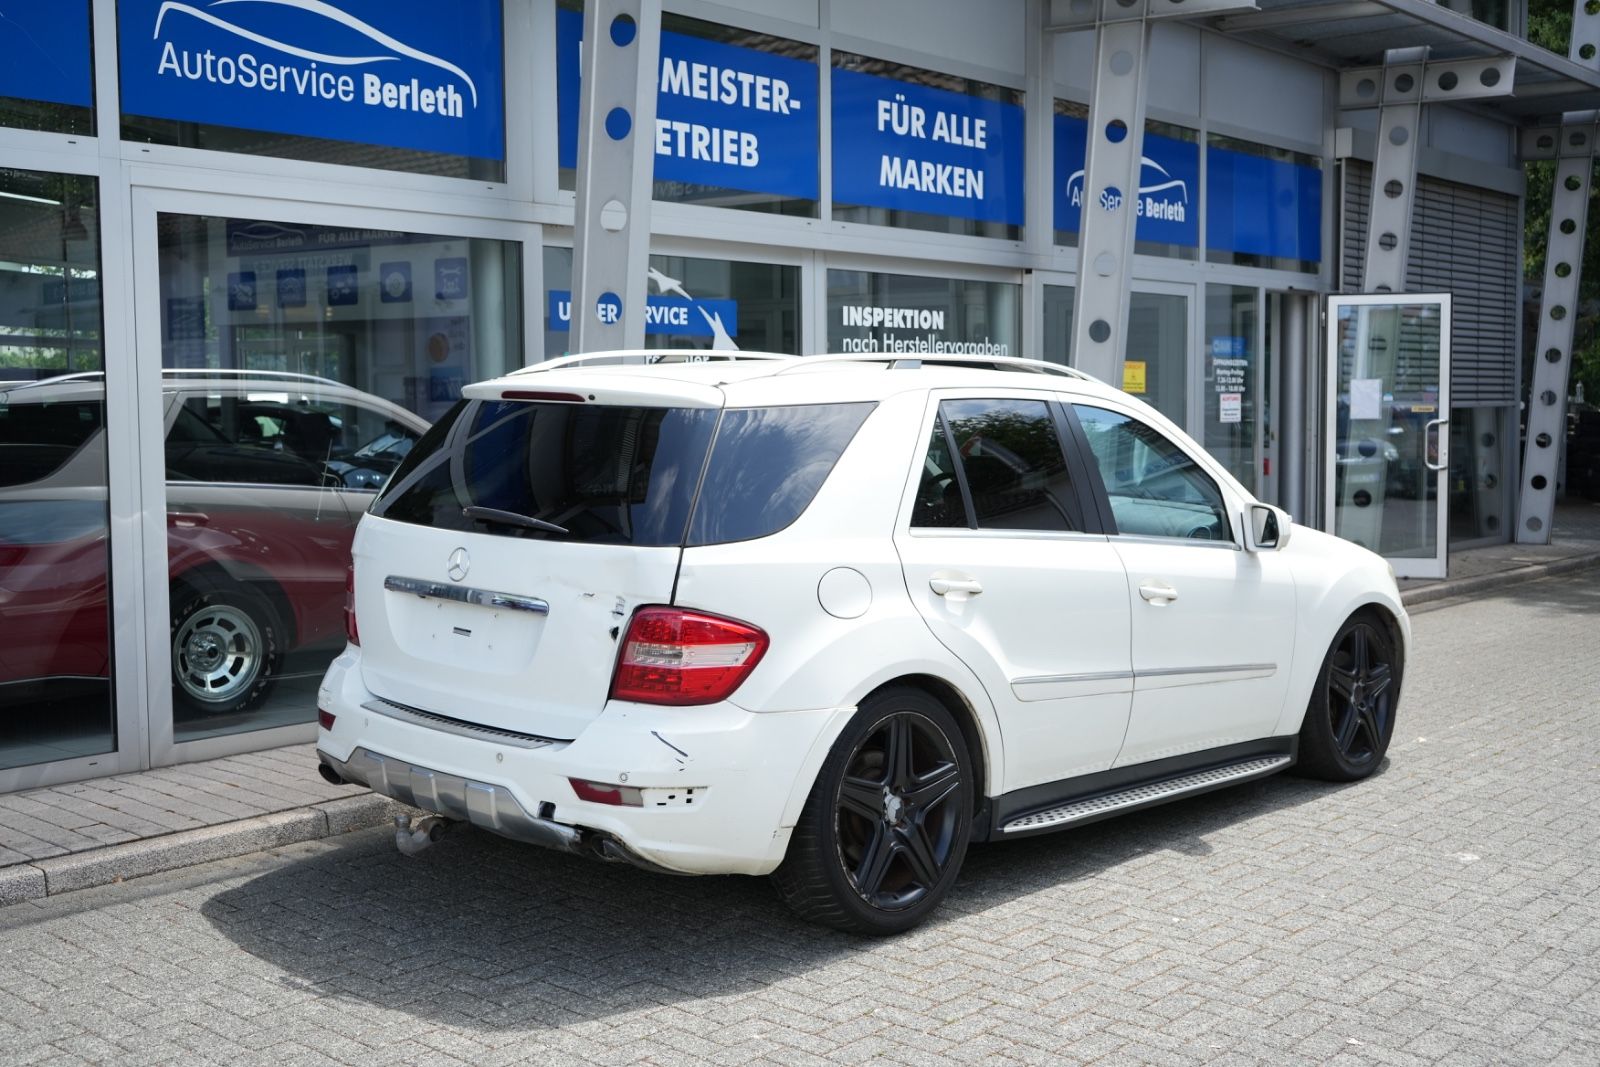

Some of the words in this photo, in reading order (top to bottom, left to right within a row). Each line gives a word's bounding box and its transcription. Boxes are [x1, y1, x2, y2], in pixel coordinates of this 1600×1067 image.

[157, 41, 355, 102] AutoService
[363, 73, 464, 118] Berleth
[660, 57, 801, 115] MEISTER-
[655, 118, 760, 168] ETRIEB
[878, 93, 926, 139] FÜR
[932, 111, 987, 149] ALLE
[880, 154, 985, 200] MARKEN
[1145, 197, 1186, 222] Berleth
[558, 301, 618, 323] UER
[644, 305, 689, 326] RVICE
[842, 305, 945, 330] INSPEKTION
[842, 332, 878, 352] nach
